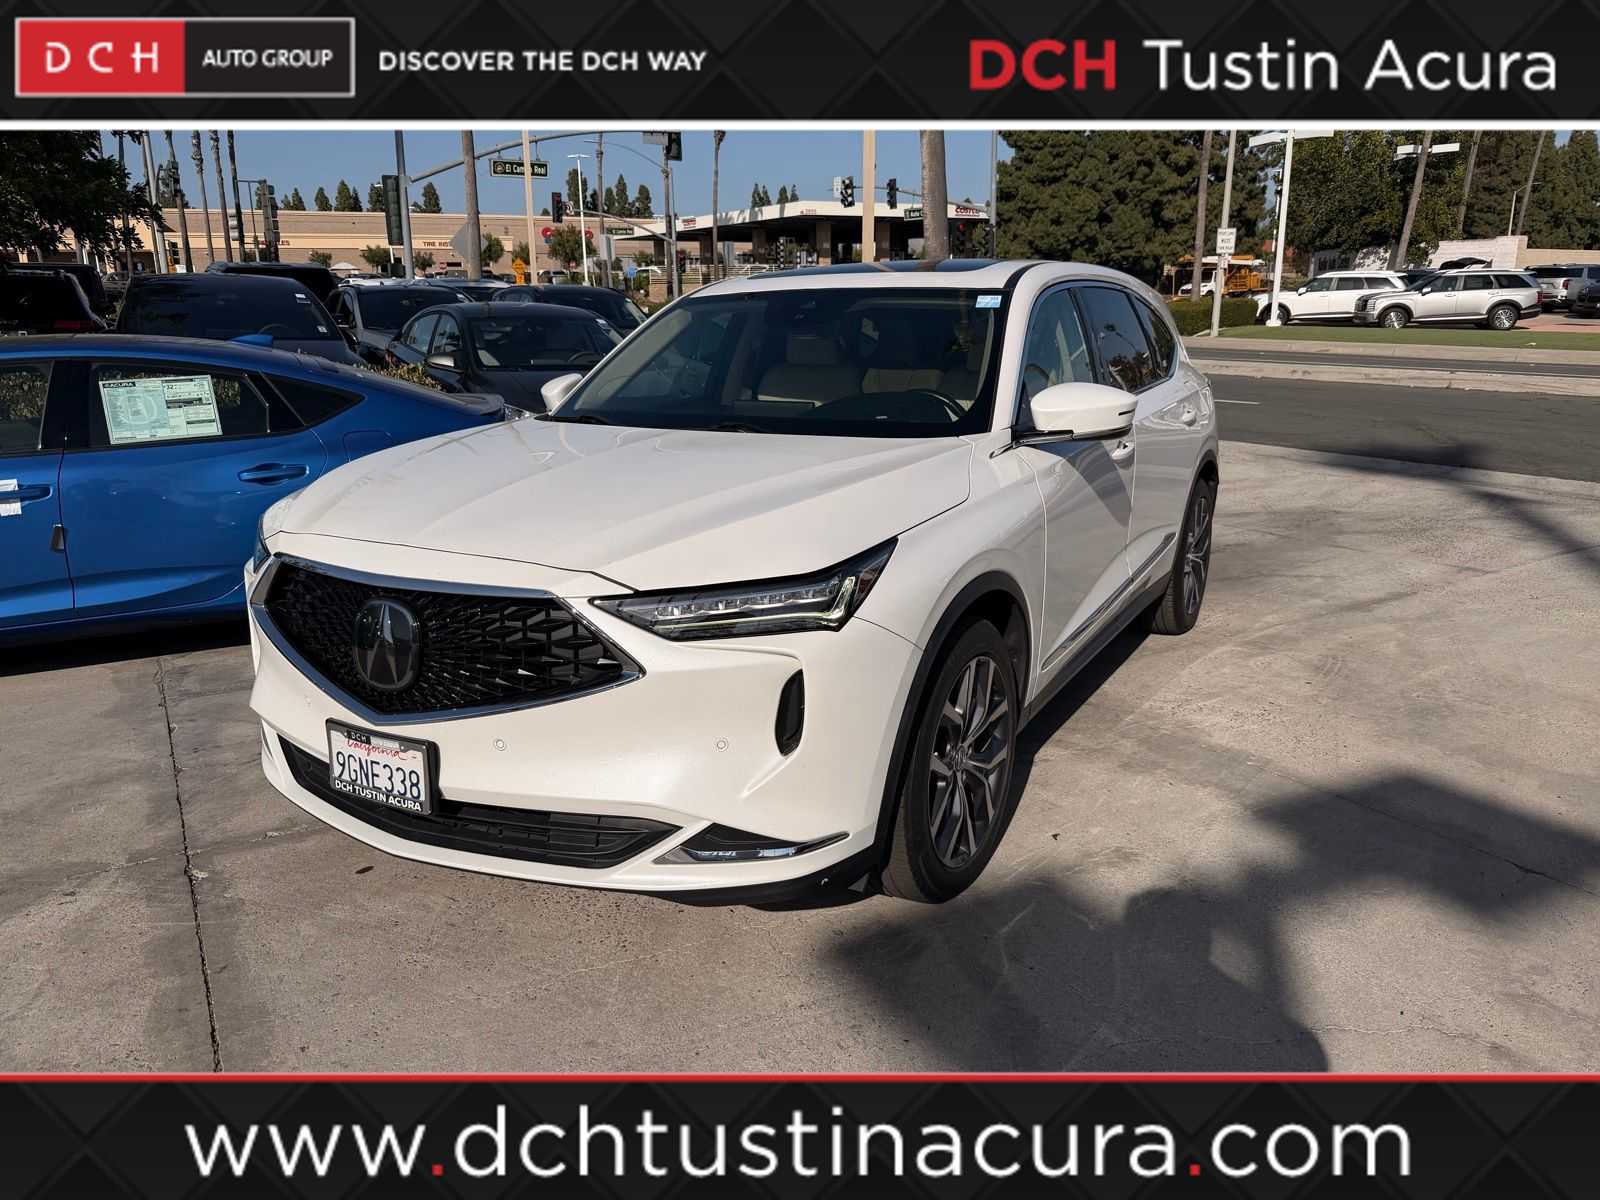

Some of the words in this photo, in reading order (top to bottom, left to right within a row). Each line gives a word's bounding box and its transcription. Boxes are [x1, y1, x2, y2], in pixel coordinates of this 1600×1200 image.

[335, 779, 353, 791] DCH
[354, 785, 387, 802] TUSTIN
[388, 796, 422, 811] ACURA
[336, 751, 421, 800] 9GNE338
